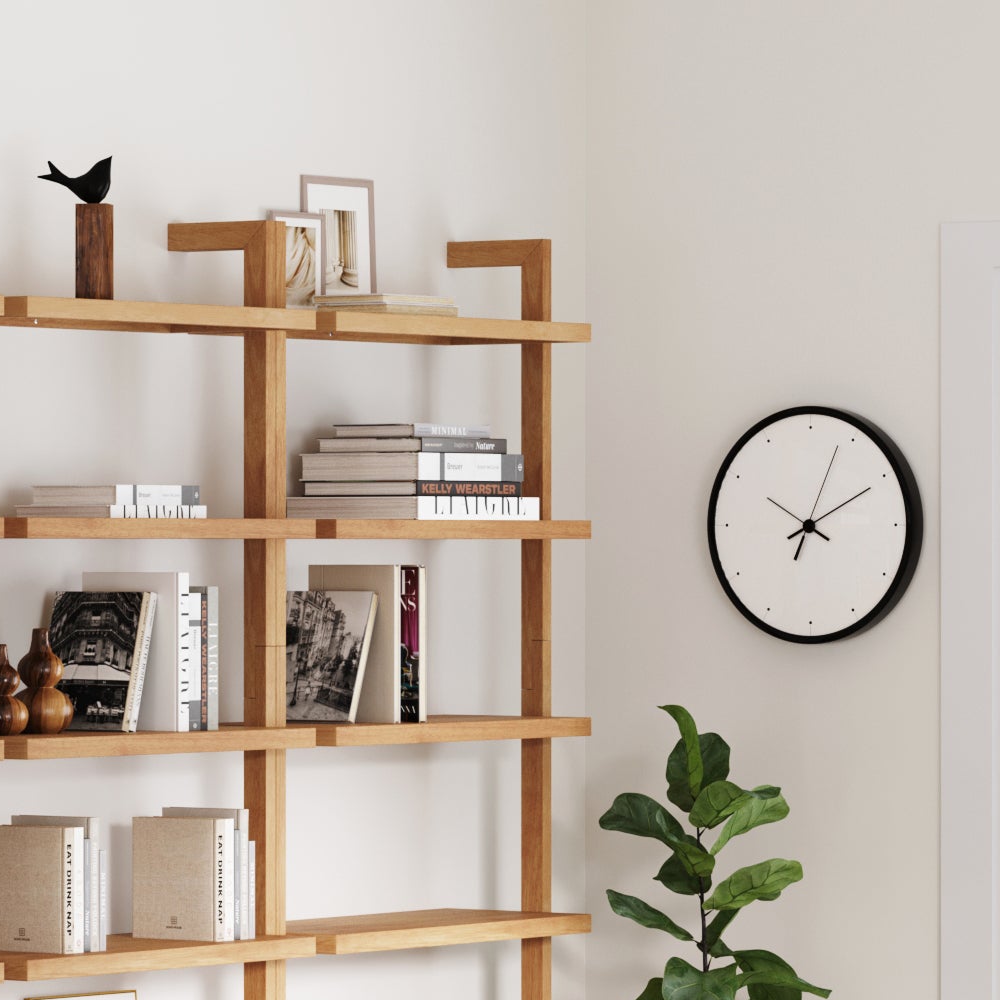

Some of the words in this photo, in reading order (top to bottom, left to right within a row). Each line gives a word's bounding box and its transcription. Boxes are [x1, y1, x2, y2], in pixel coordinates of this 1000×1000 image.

[431, 426, 467, 436] MINIMAL
[475, 441, 496, 451] Nature
[421, 483, 453, 494] KELLY
[455, 484, 516, 495] WEARSTLER
